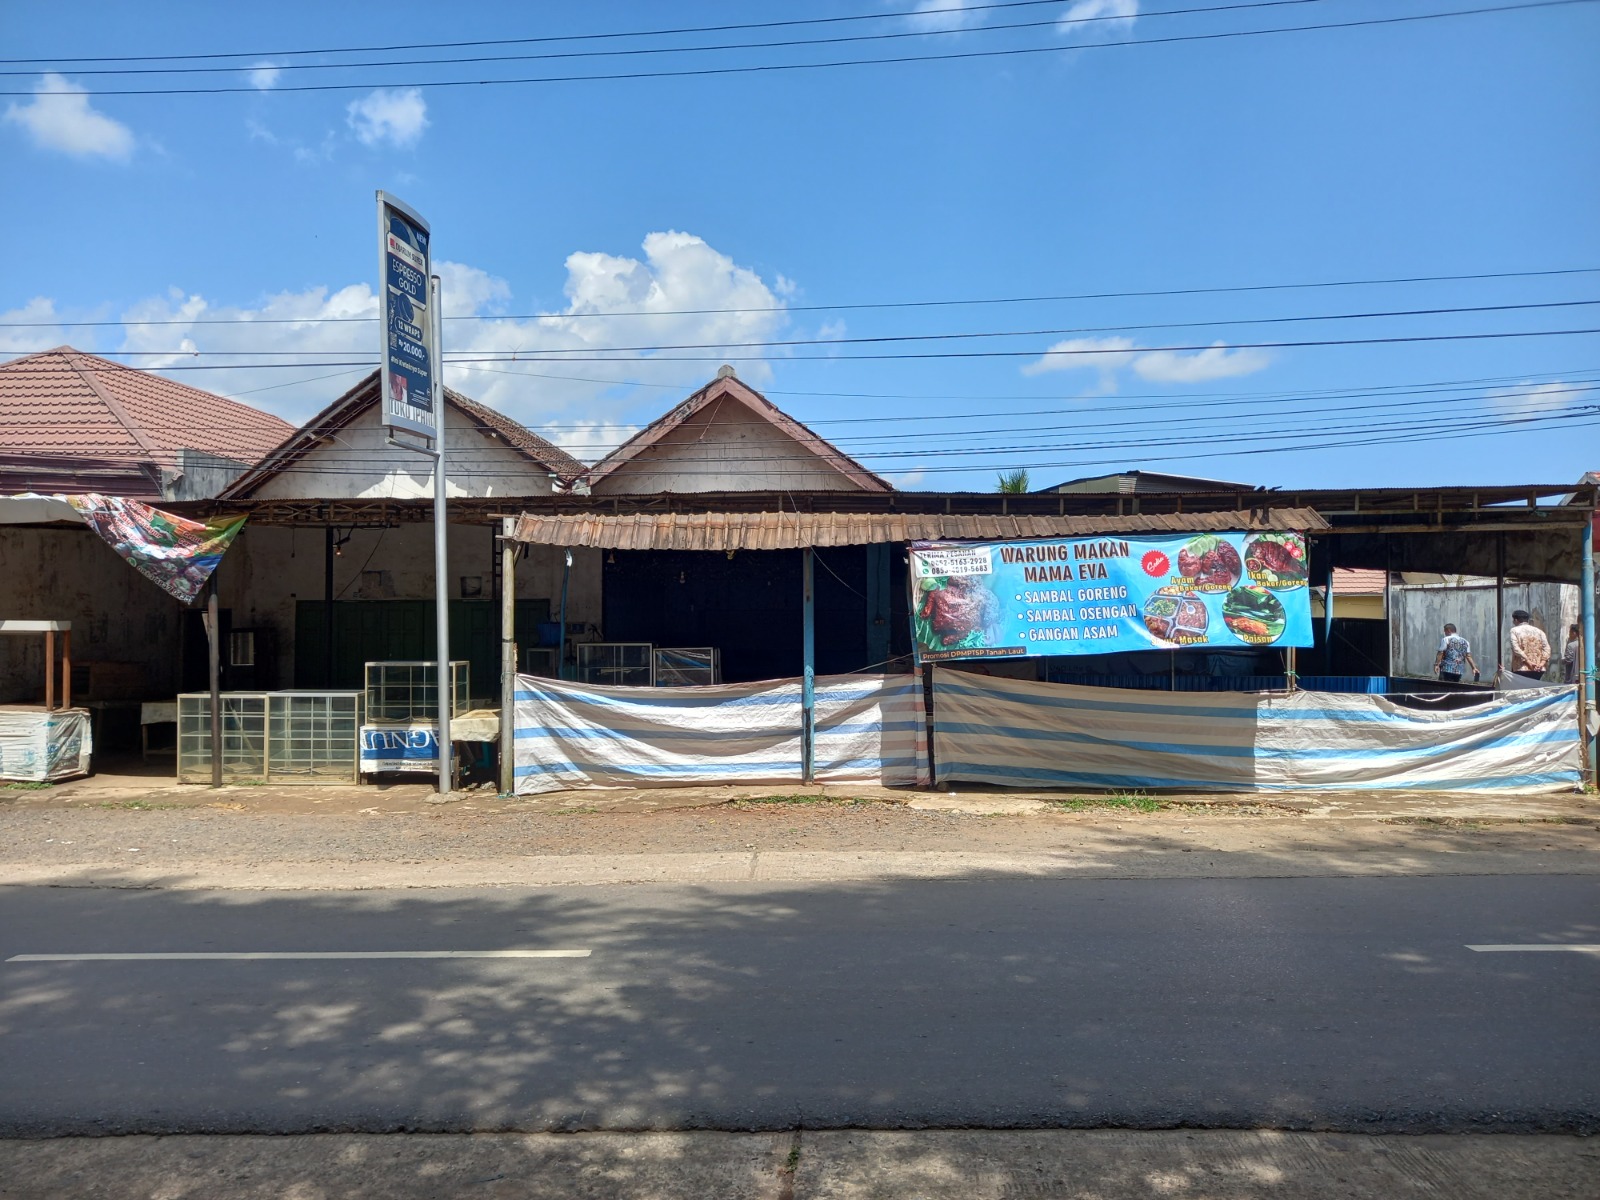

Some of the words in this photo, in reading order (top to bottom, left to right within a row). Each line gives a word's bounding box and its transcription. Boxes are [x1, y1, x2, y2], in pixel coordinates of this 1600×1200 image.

[392, 258, 422, 286] ESPRESSO
[398, 277, 416, 295] GOLD
[1000, 545, 1068, 564] WARUNG
[1074, 541, 1129, 560] MAKAN
[1024, 565, 1073, 583] MAMA
[1078, 562, 1108, 580] EVA
[1248, 571, 1267, 581] Ikan
[1170, 576, 1195, 586] Ayam
[1256, 579, 1309, 588] Bakar/Goreng
[1024, 589, 1074, 603] SAMBAL
[1078, 586, 1127, 601] GORENG
[1178, 584, 1233, 593] Bakar/Goreng
[1026, 608, 1076, 622] SAMBAL
[1080, 604, 1137, 620] OSENGAN
[1029, 627, 1079, 641] GANGAN
[1083, 625, 1118, 639] ASAM
[1179, 634, 1210, 645] Masak
[1243, 633, 1273, 644] Paisan
[922, 651, 949, 660] Promosi
[950, 648, 985, 658] DPMPTSP
[986, 648, 1007, 656] Tanah
[1008, 647, 1024, 656] Laut
